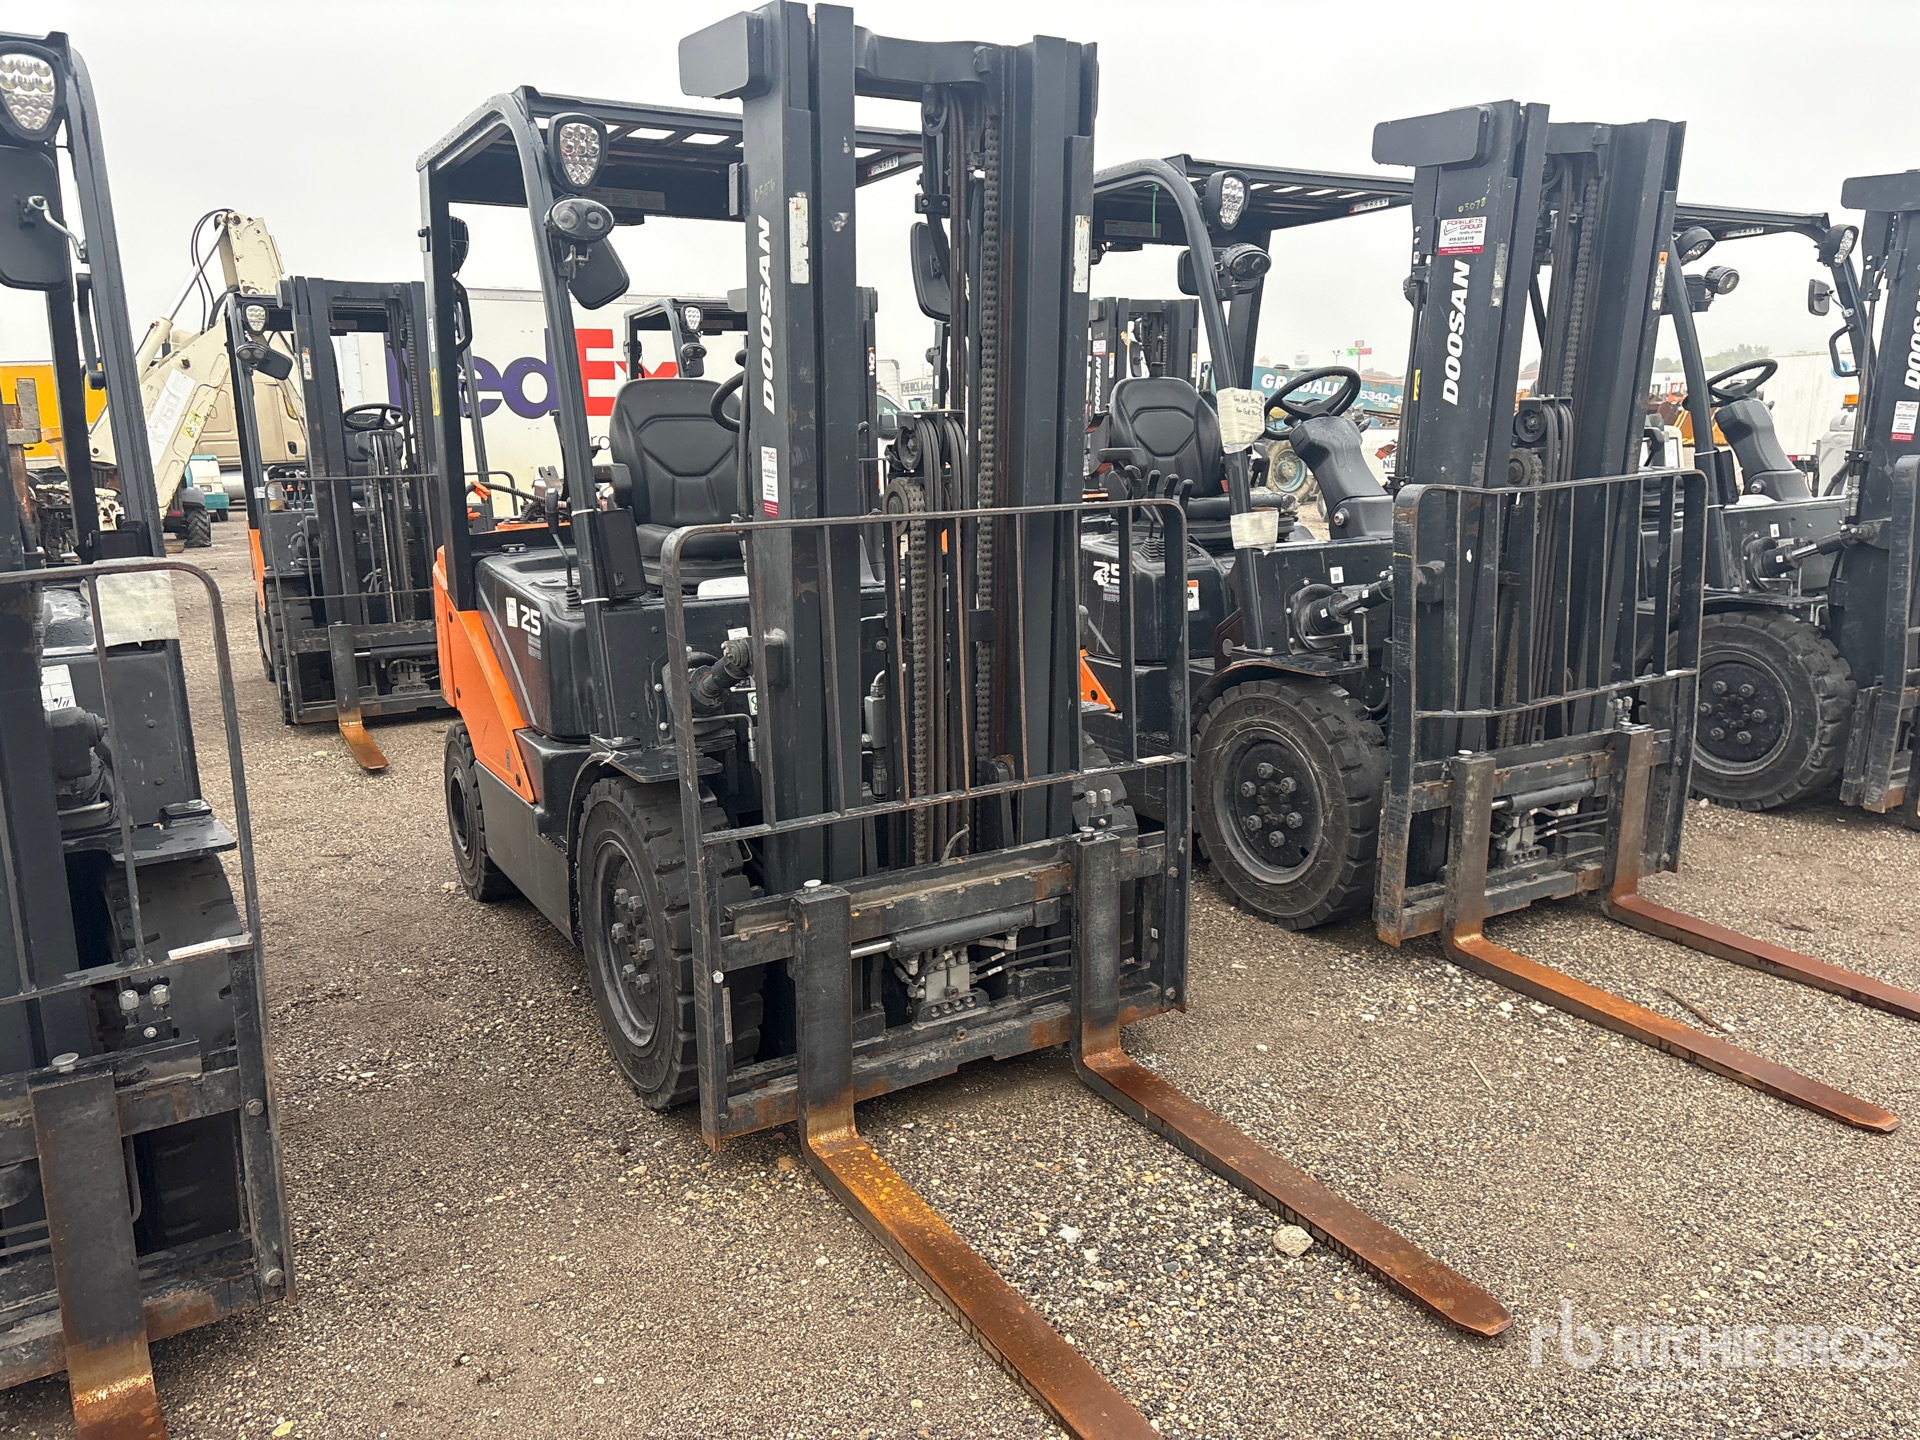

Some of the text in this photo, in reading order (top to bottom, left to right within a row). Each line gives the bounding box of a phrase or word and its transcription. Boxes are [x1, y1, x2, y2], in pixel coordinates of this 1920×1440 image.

[1447, 218, 1484, 226] FORKLIFTS
[757, 214, 775, 416] DOOSAN
[1442, 259, 1471, 406] DOOSAN
[1260, 373, 1344, 396] GRDALL
[520, 604, 541, 636] 25
